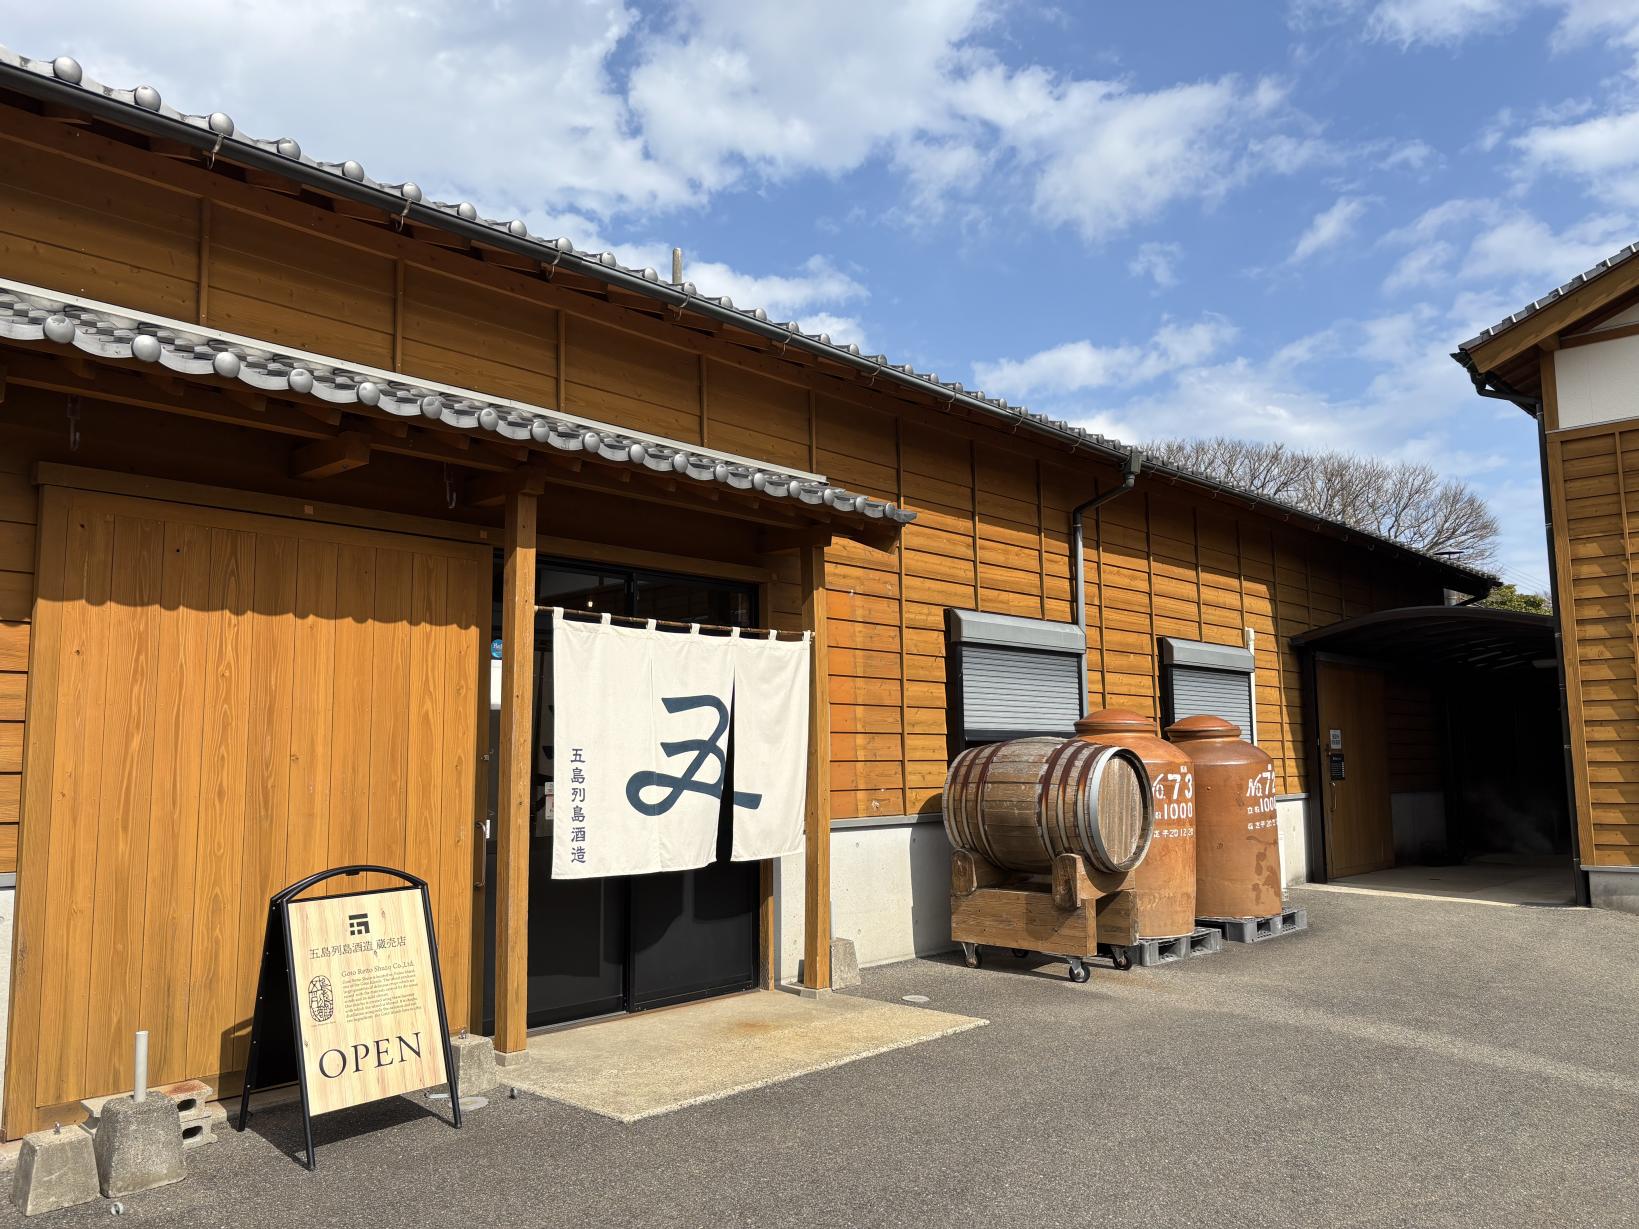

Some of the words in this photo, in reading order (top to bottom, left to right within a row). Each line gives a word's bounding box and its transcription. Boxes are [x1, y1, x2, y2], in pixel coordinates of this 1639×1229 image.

[570, 747, 587, 864] 五島列島酒造
[1163, 802, 1193, 820] 1000
[309, 940, 374, 960] 五島列島酒造
[376, 935, 407, 949] 蔵売店
[318, 1031, 423, 1079] OPEN
